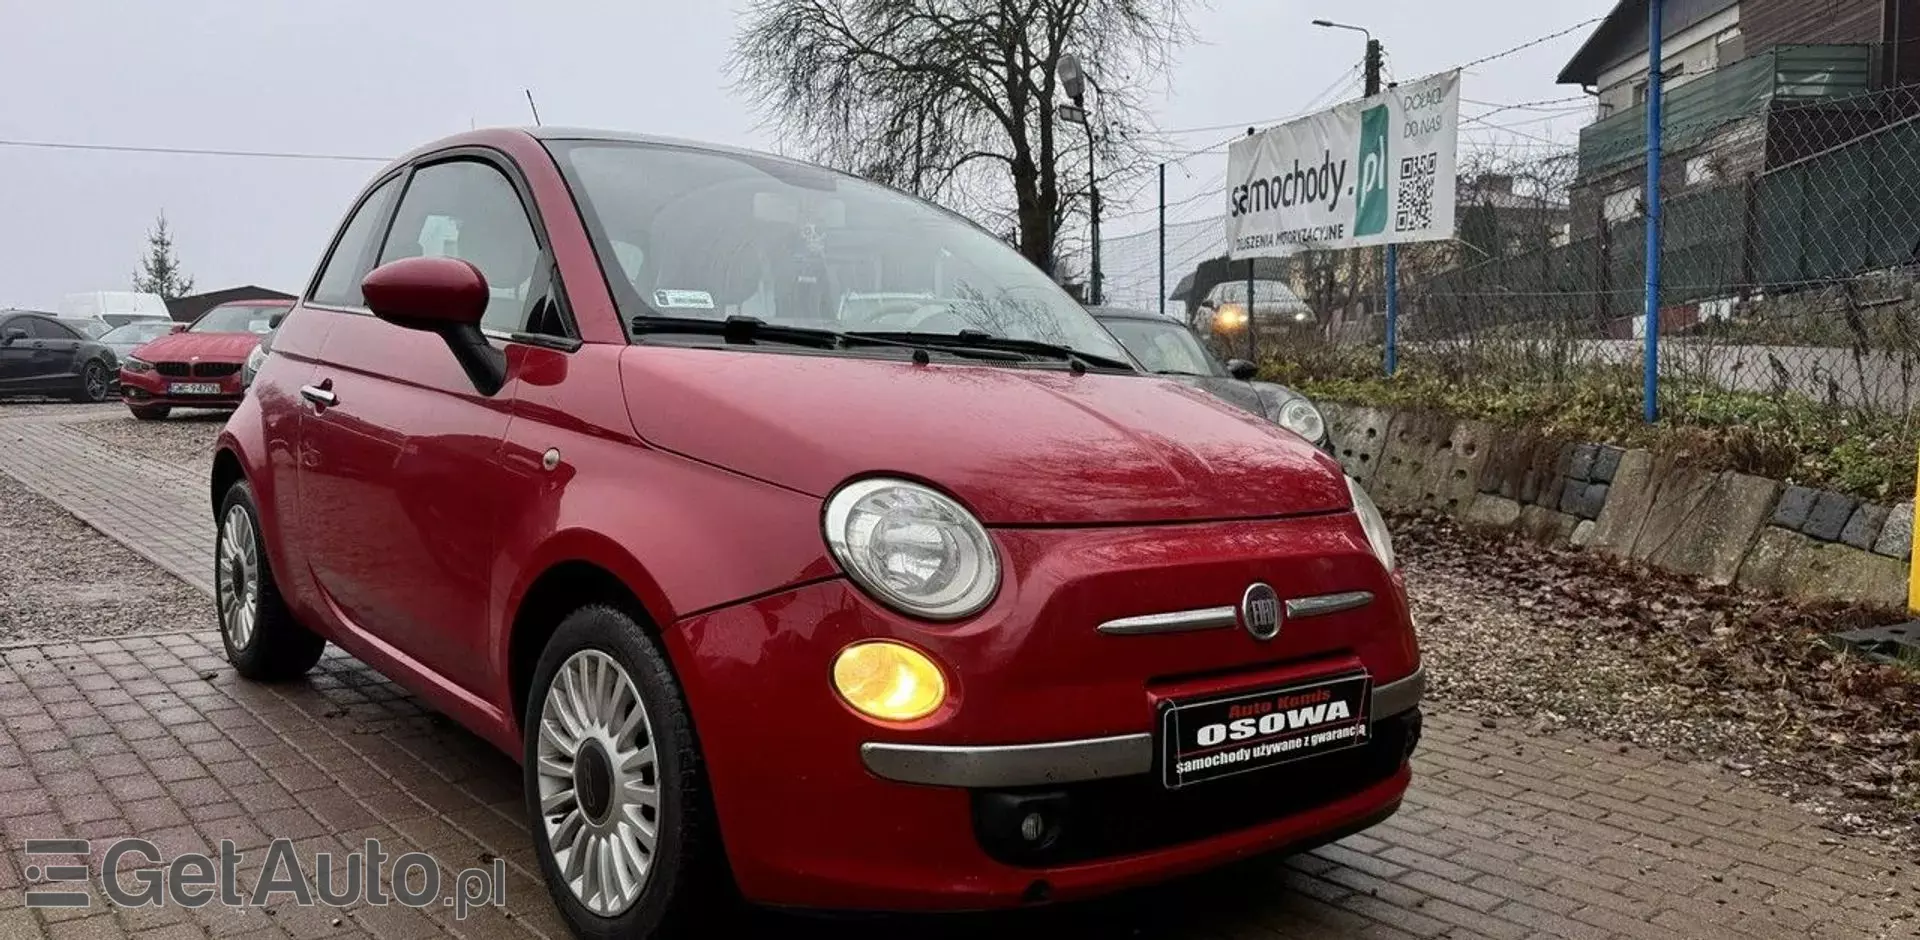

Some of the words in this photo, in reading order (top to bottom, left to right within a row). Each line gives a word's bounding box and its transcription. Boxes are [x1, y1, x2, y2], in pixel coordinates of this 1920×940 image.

[1403, 120, 1419, 138] DO
[1251, 598, 1277, 626] FIAT
[1229, 703, 1272, 719] Auto
[1278, 688, 1332, 711] Komis
[1196, 700, 1350, 746] OSOWA
[1176, 748, 1250, 774] samochody
[1252, 735, 1302, 758] używane
[1303, 736, 1310, 747] z
